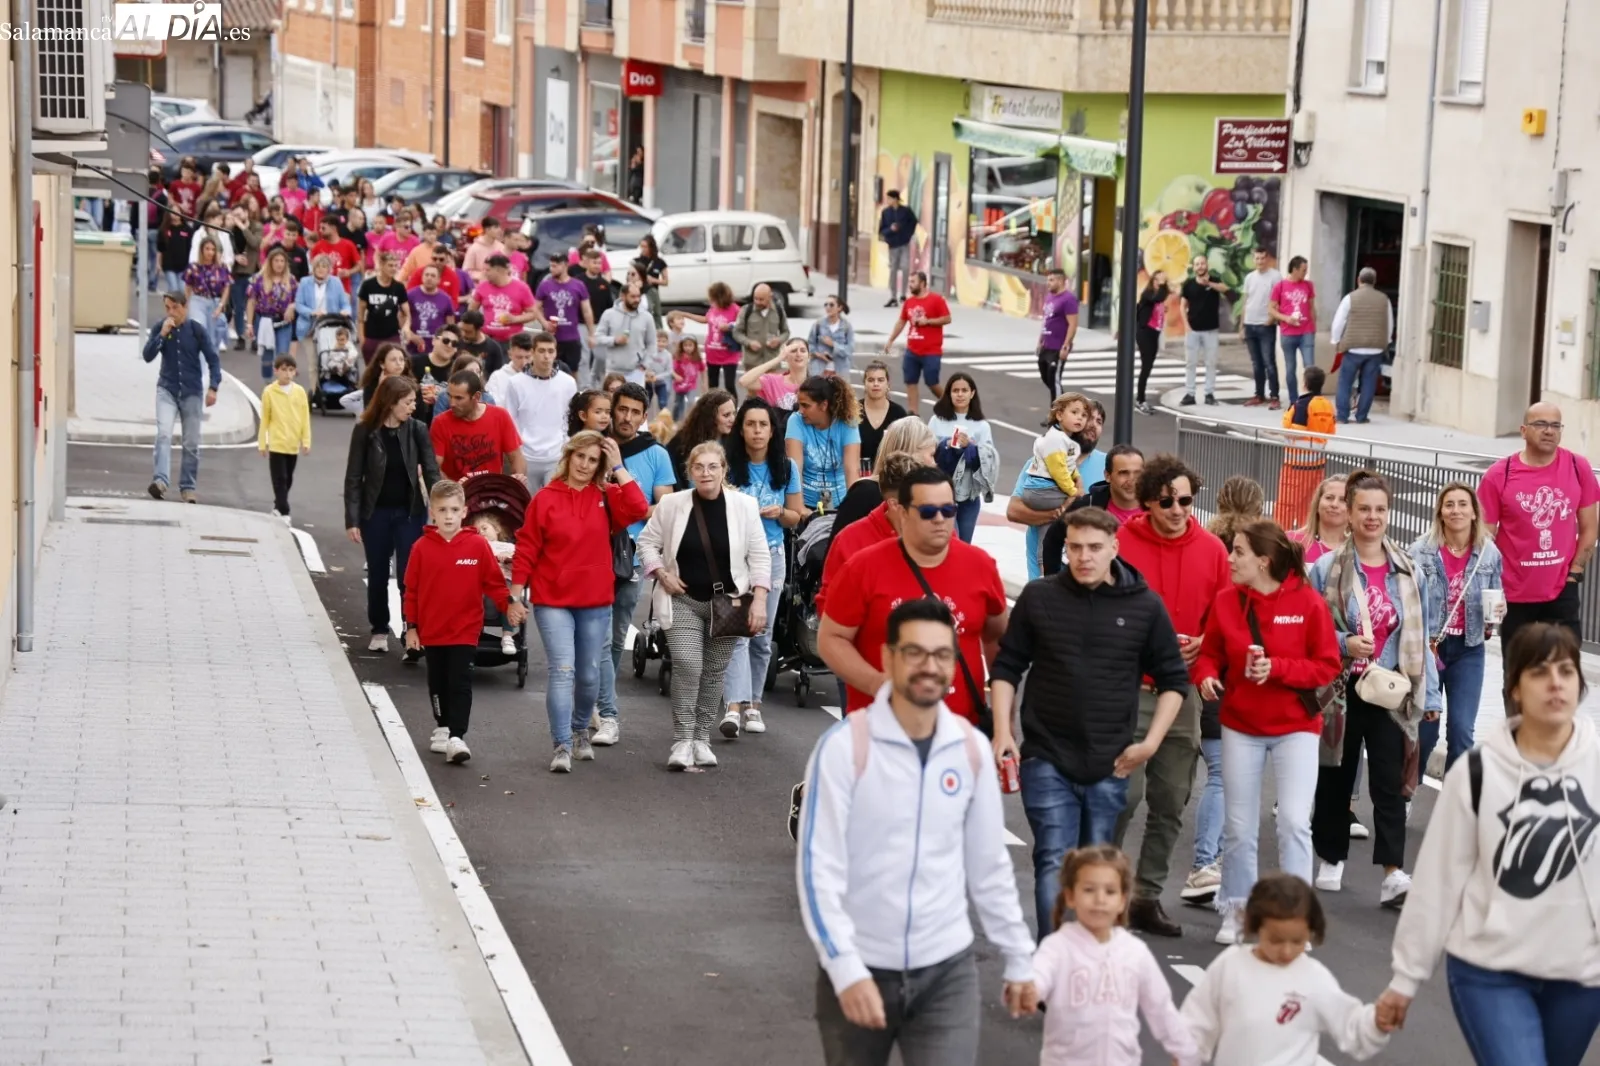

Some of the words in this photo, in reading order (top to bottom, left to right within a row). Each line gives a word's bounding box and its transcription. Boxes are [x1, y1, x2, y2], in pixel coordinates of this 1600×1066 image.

[1221, 123, 1288, 138] Panificadora
[1223, 136, 1244, 148] Los
[1245, 136, 1286, 149] Villares
[1532, 550, 1558, 559] FIESTAS
[455, 558, 478, 566] MARIO
[1273, 615, 1305, 625] PATRICIA
